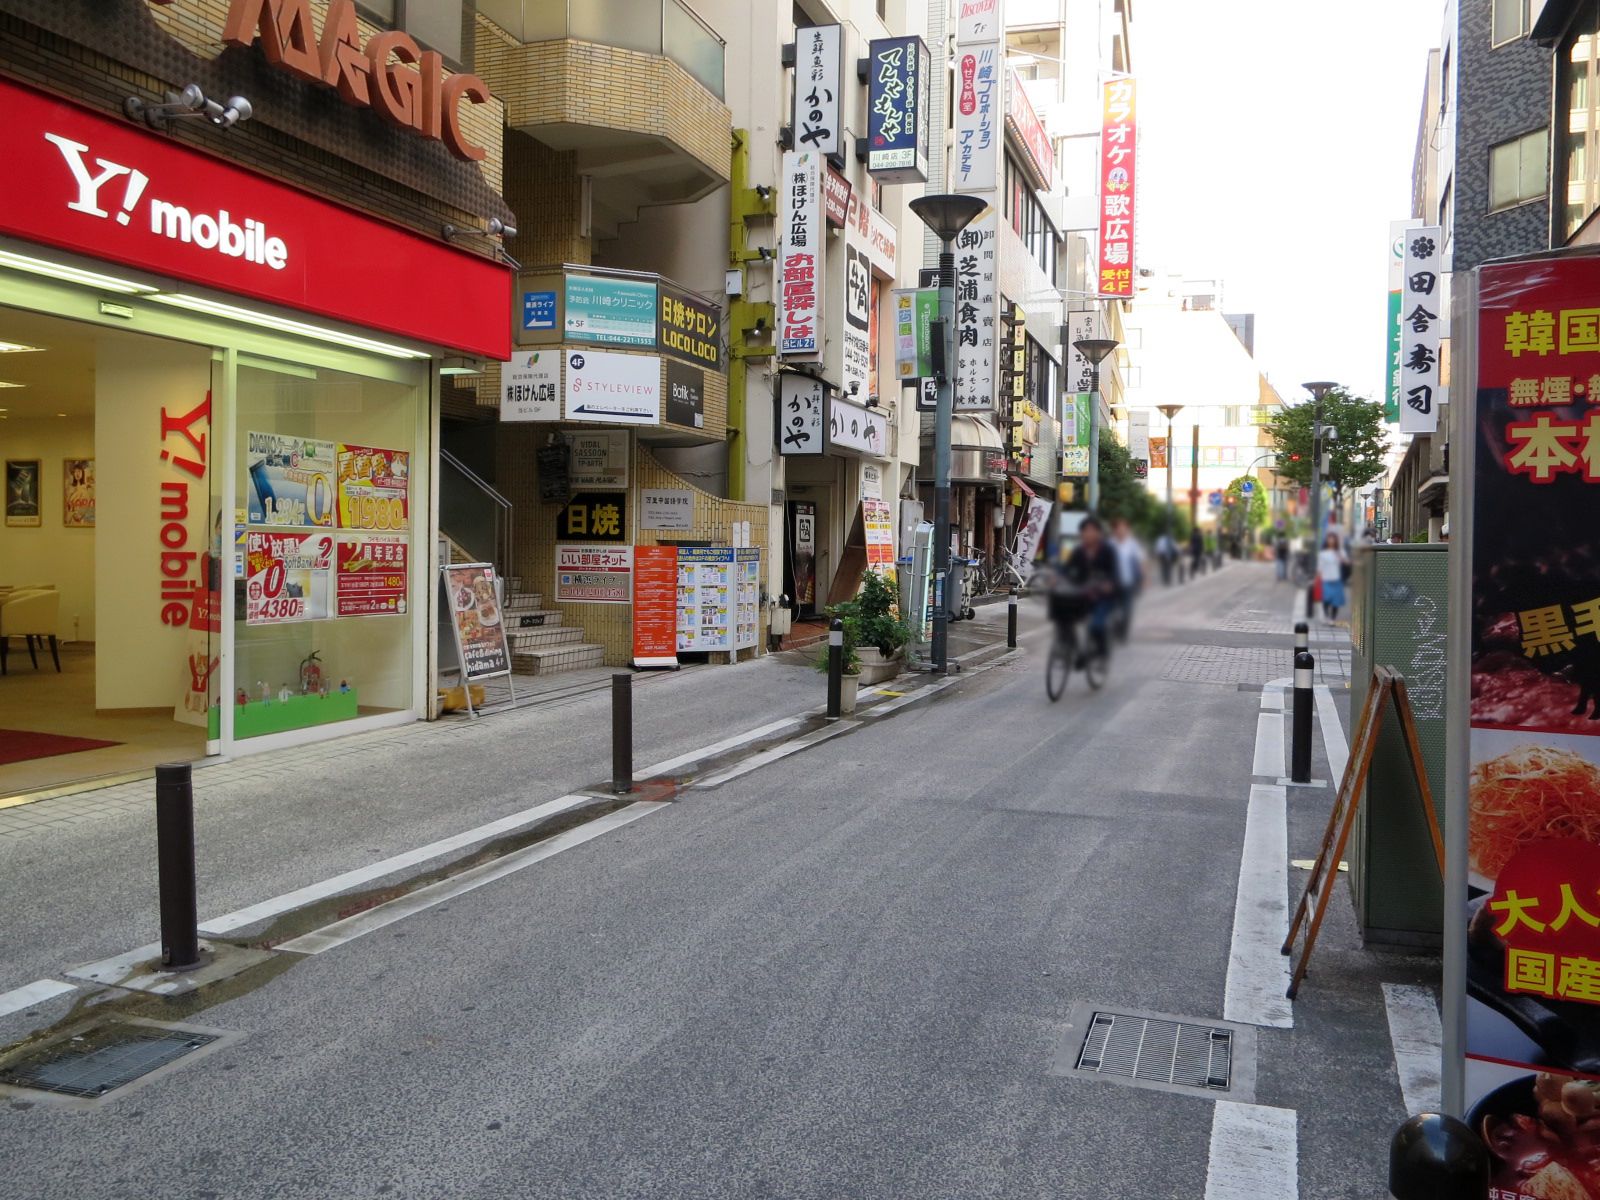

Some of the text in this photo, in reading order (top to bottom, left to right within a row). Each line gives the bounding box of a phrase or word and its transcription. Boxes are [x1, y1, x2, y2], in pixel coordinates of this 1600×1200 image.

[974, 22, 987, 34] 7F
[222, 0, 491, 161] MAGIC
[963, 57, 973, 112] やせる教室
[977, 50, 996, 150] 川崎プロポーション
[799, 86, 833, 148] かのや
[960, 129, 974, 182] アカデミー
[1104, 81, 1132, 265] カラオケ 歌広場
[44, 132, 288, 270] Y! mobile
[1101, 269, 1131, 280] 受付
[1102, 281, 1131, 293] 4F
[592, 296, 653, 310] 川崎クリニック
[662, 296, 717, 338] 日焼サロン
[783, 253, 815, 339] お部屋探しは
[575, 320, 584, 328] 5F
[1403, 271, 1437, 415] 田舎寿司
[571, 358, 584, 367] 4F
[587, 381, 654, 395] STYLEVIEW
[784, 394, 811, 449] かのや
[830, 406, 876, 449] かのや
[160, 390, 212, 627] Y! mobile
[348, 496, 403, 530] 1980
[567, 503, 620, 535] 日焼
[263, 558, 286, 598] 0
[284, 556, 312, 569] SoftBank
[561, 553, 627, 565] いい部屋ネット
[260, 599, 298, 619] 4380
[1491, 884, 1600, 937] 大人
[1508, 947, 1600, 1002] 国産
